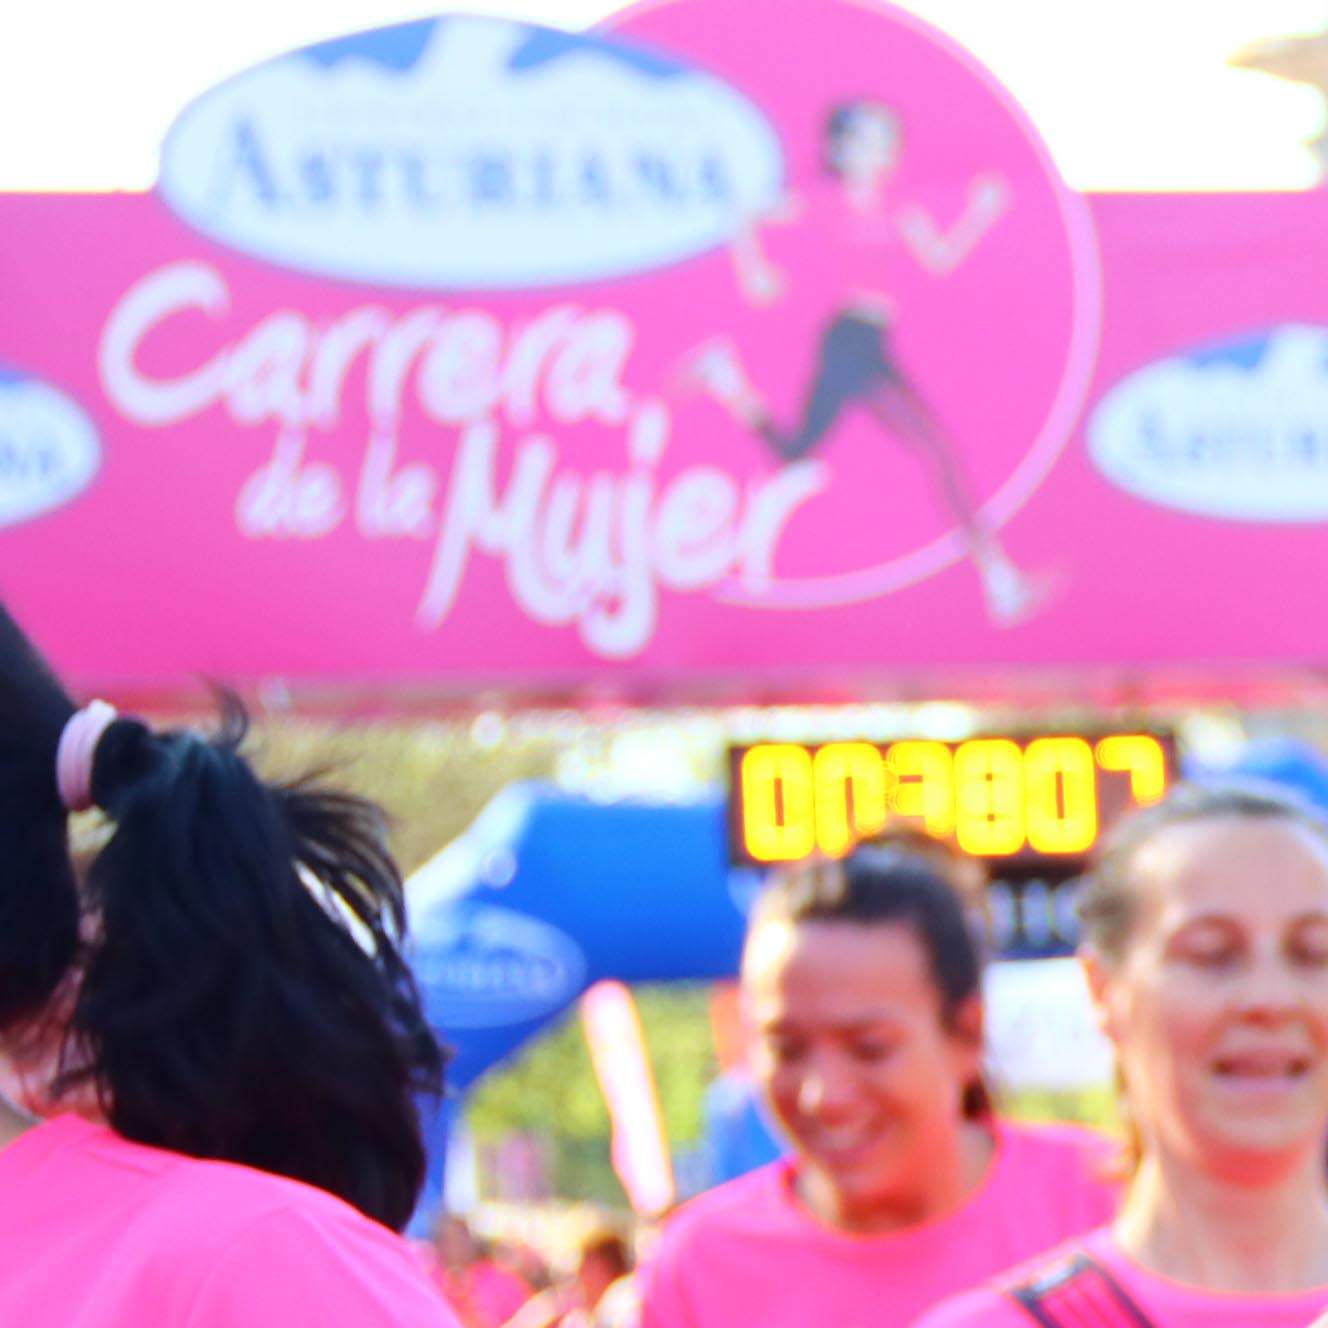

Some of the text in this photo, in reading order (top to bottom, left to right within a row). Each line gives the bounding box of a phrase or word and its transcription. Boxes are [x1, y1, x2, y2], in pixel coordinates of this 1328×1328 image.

[212, 112, 738, 214] ASTURIANA
[98, 260, 634, 428] Carrera
[234, 402, 832, 660] de la Mujer
